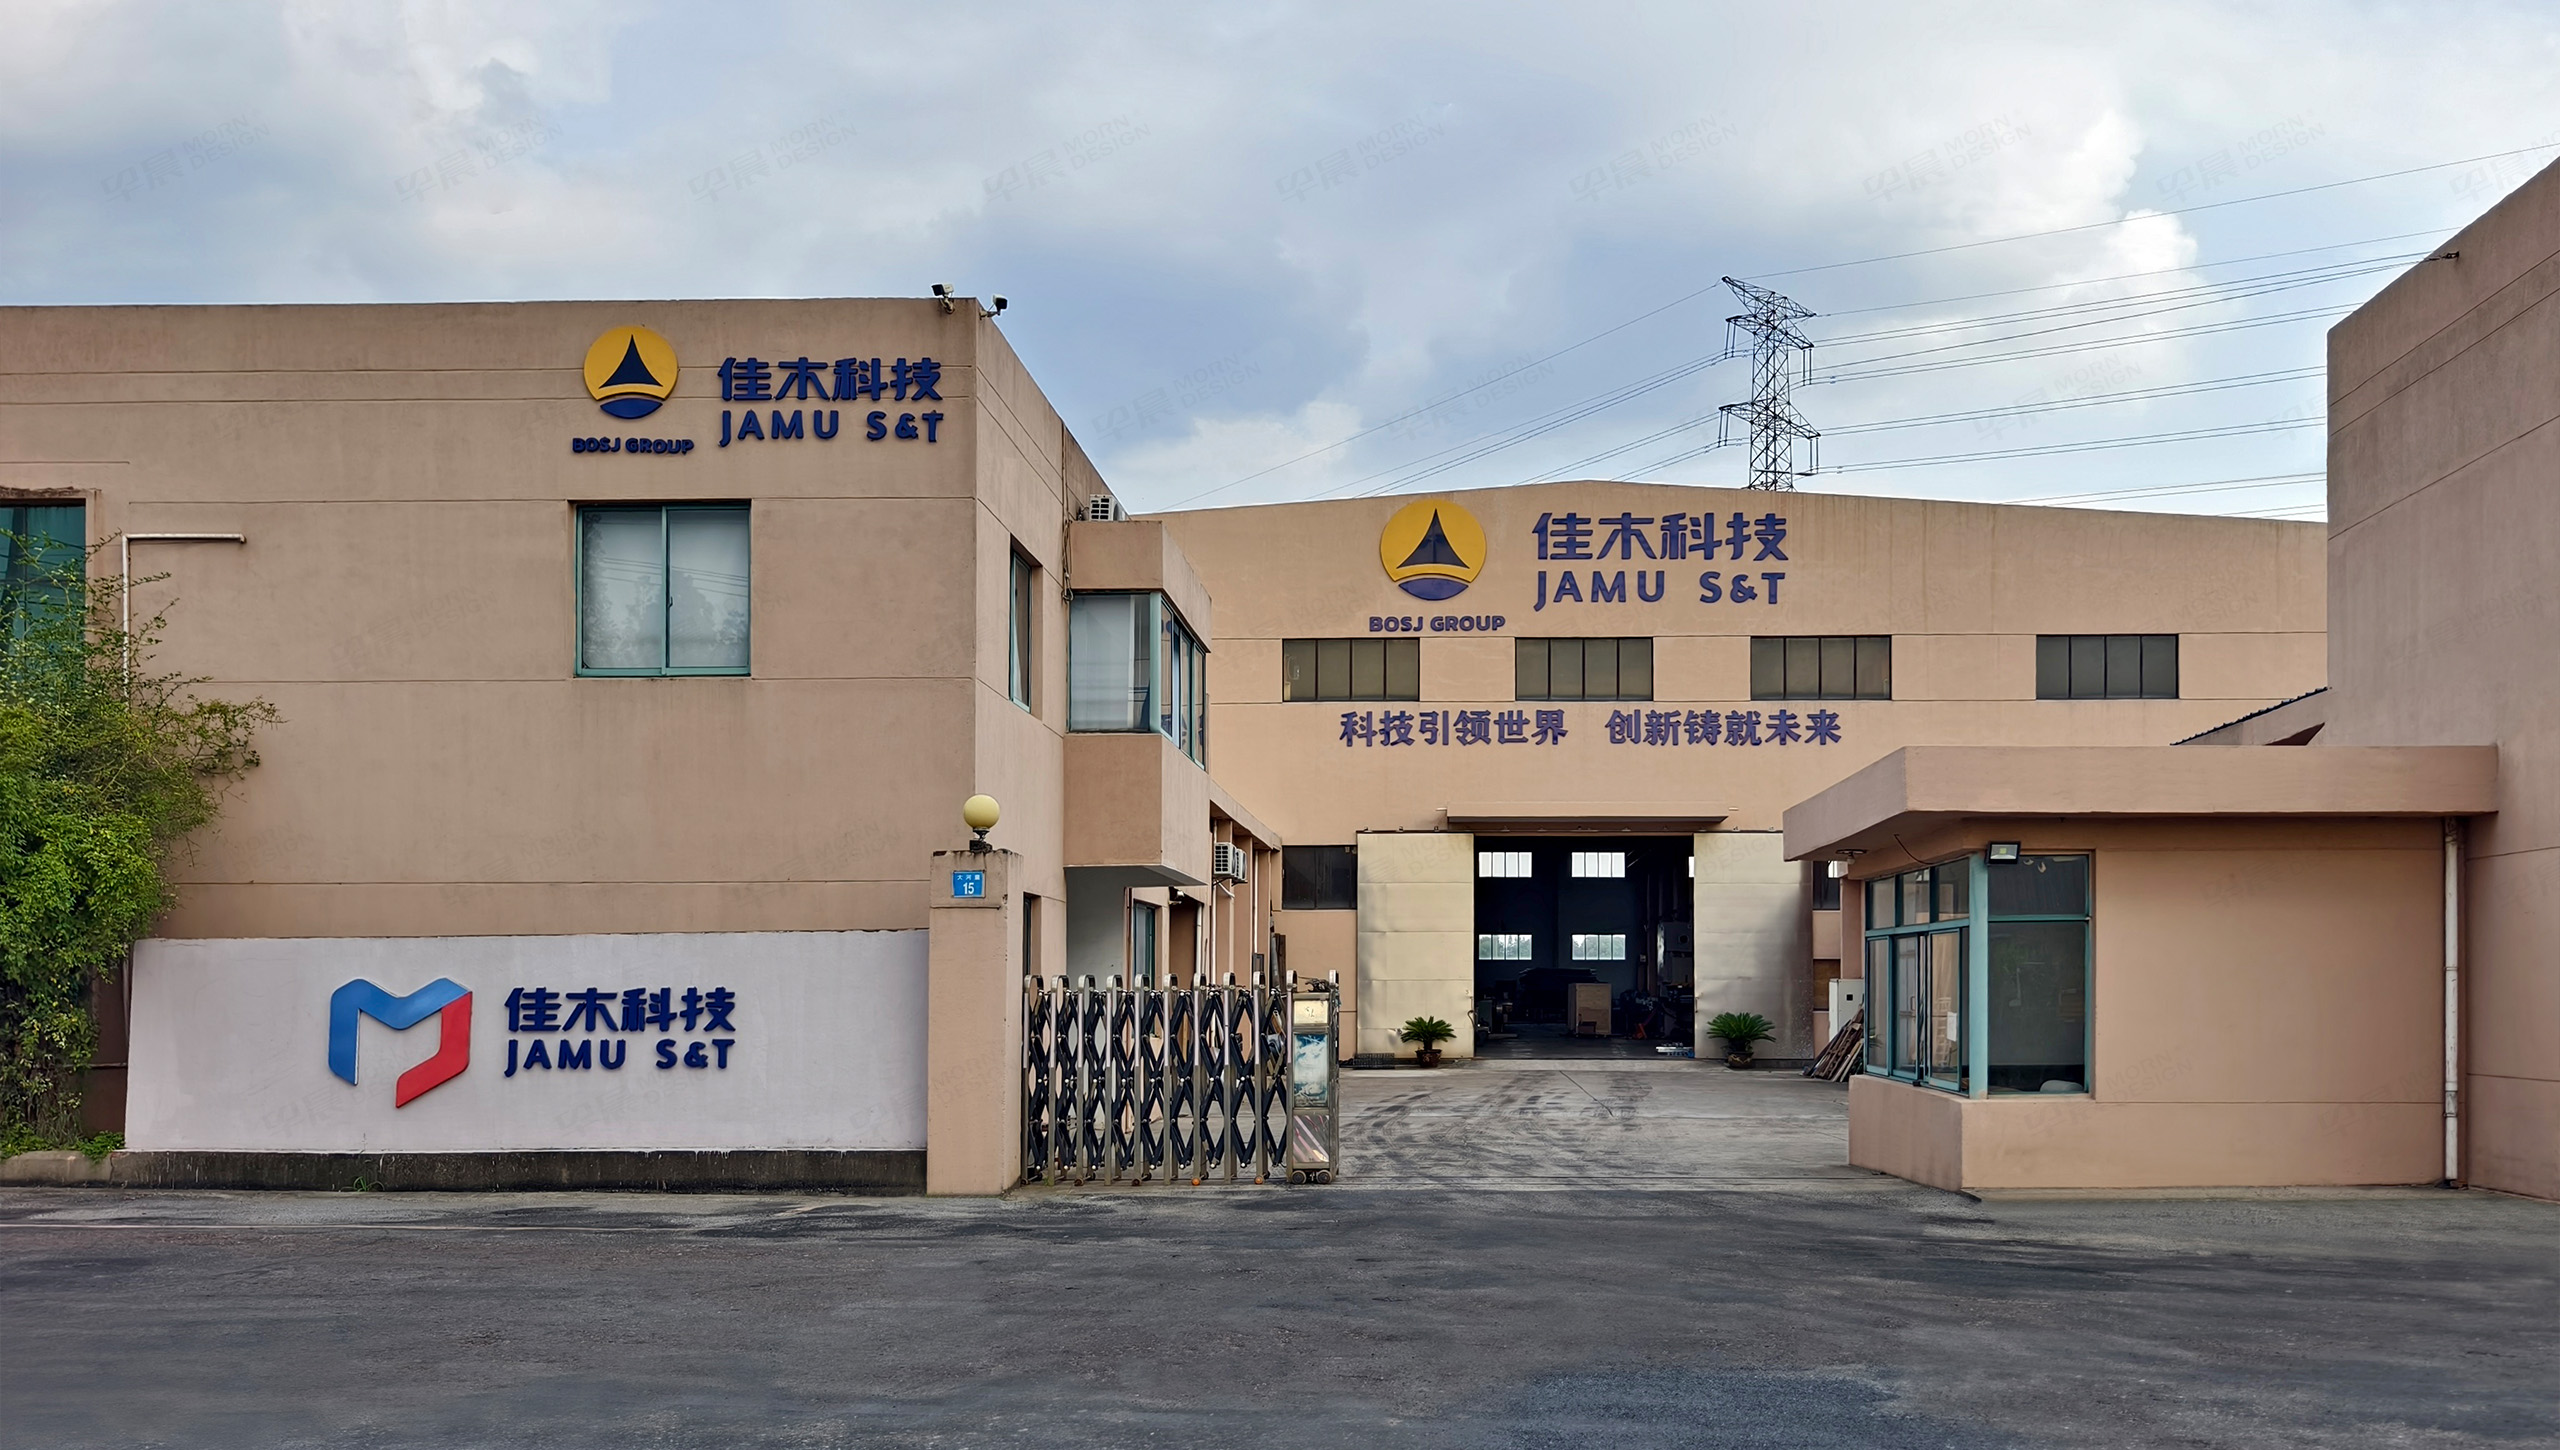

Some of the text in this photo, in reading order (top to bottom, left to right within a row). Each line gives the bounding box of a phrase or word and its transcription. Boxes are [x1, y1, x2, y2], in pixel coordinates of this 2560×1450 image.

[718, 357, 942, 401] 佳木科技
[572, 437, 694, 455] BOSJ GROUP
[719, 410, 944, 448] JAMU S&T
[1532, 512, 1788, 562] 佳木科技
[1533, 570, 1786, 612] JAMU S&T
[1369, 615, 1506, 632] BOSJ GROUP
[1340, 709, 1841, 746] 科技引领世界 创新铸就未来
[963, 882, 975, 895] 15
[503, 986, 737, 1033] 佳木科技
[503, 1038, 737, 1079] JAMU S&T
